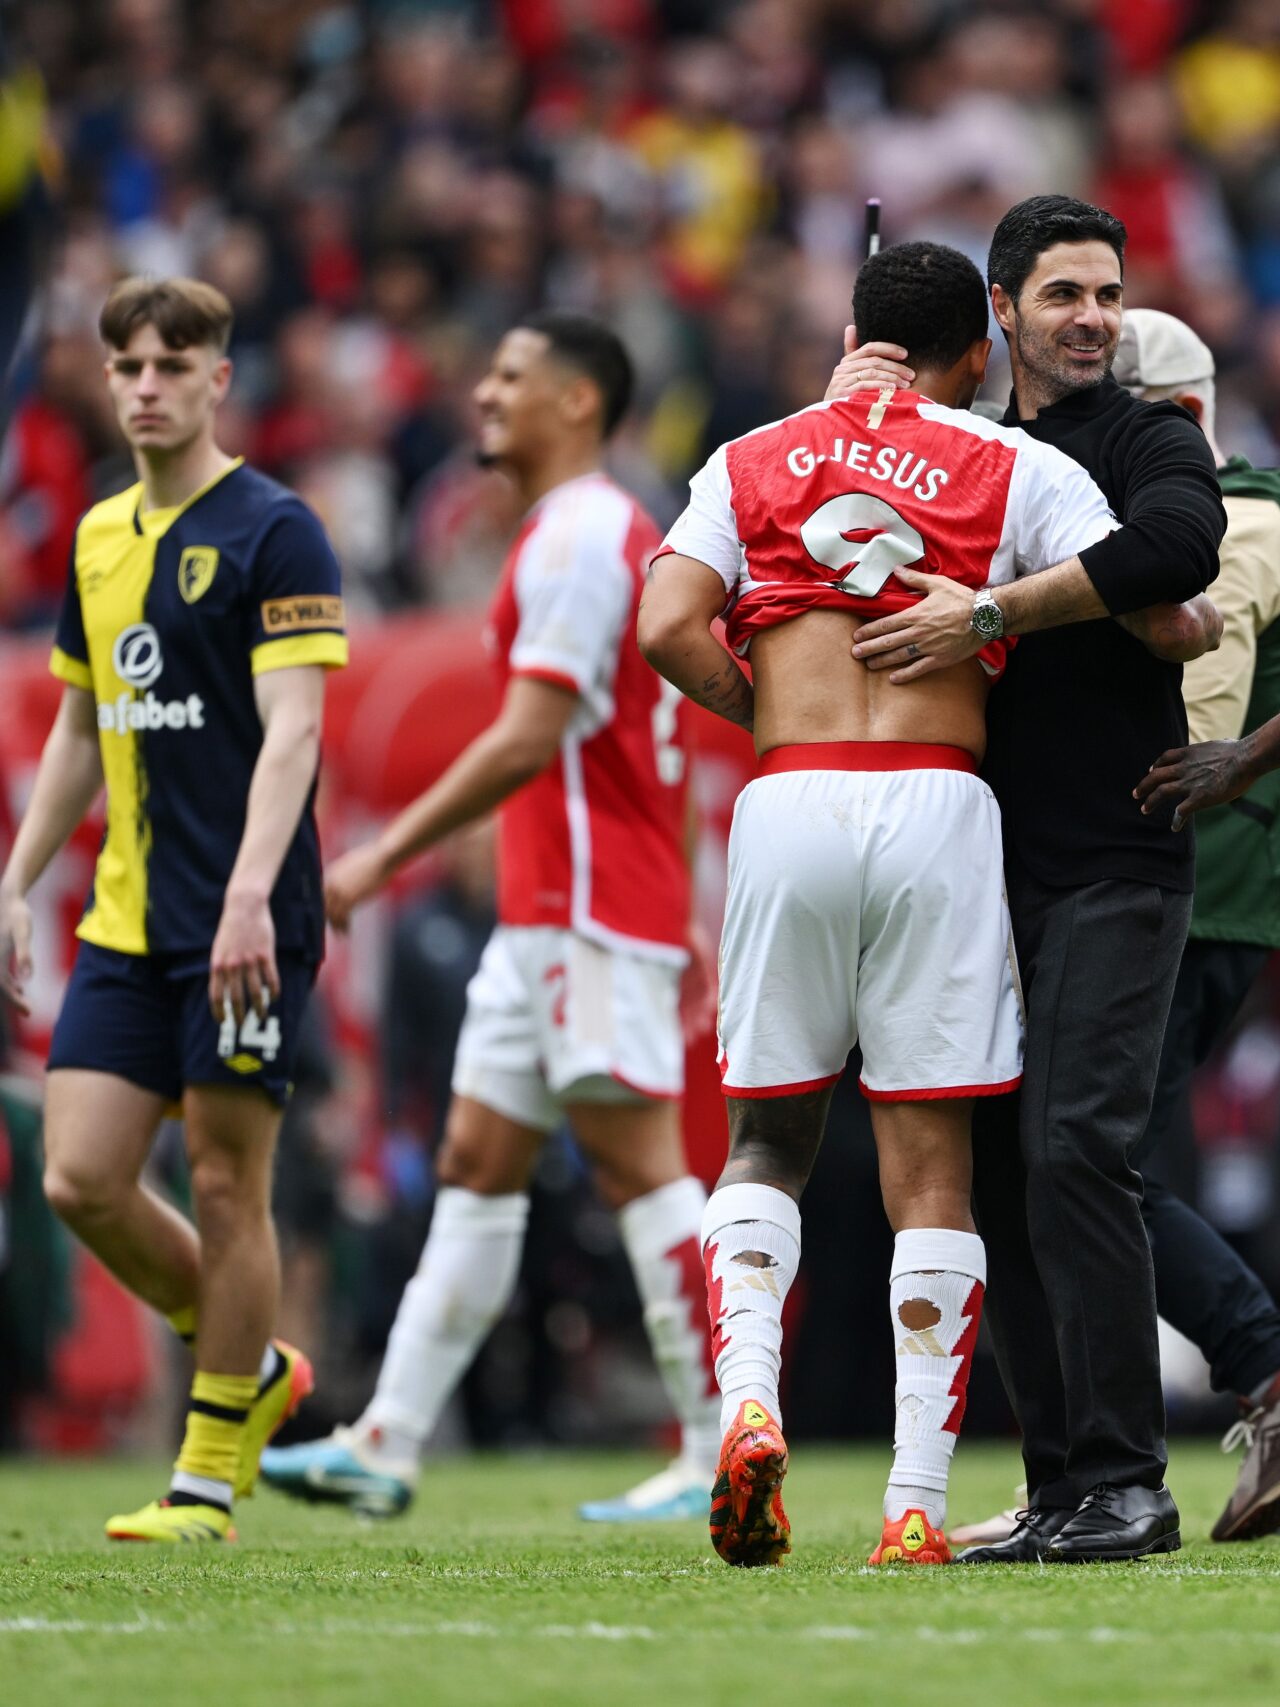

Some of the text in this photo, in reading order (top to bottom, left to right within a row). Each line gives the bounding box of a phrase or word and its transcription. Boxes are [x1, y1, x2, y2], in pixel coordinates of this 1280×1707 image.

[787, 438, 948, 501] G.JESUS
[800, 491, 926, 598] 9
[97, 690, 205, 736] afabet
